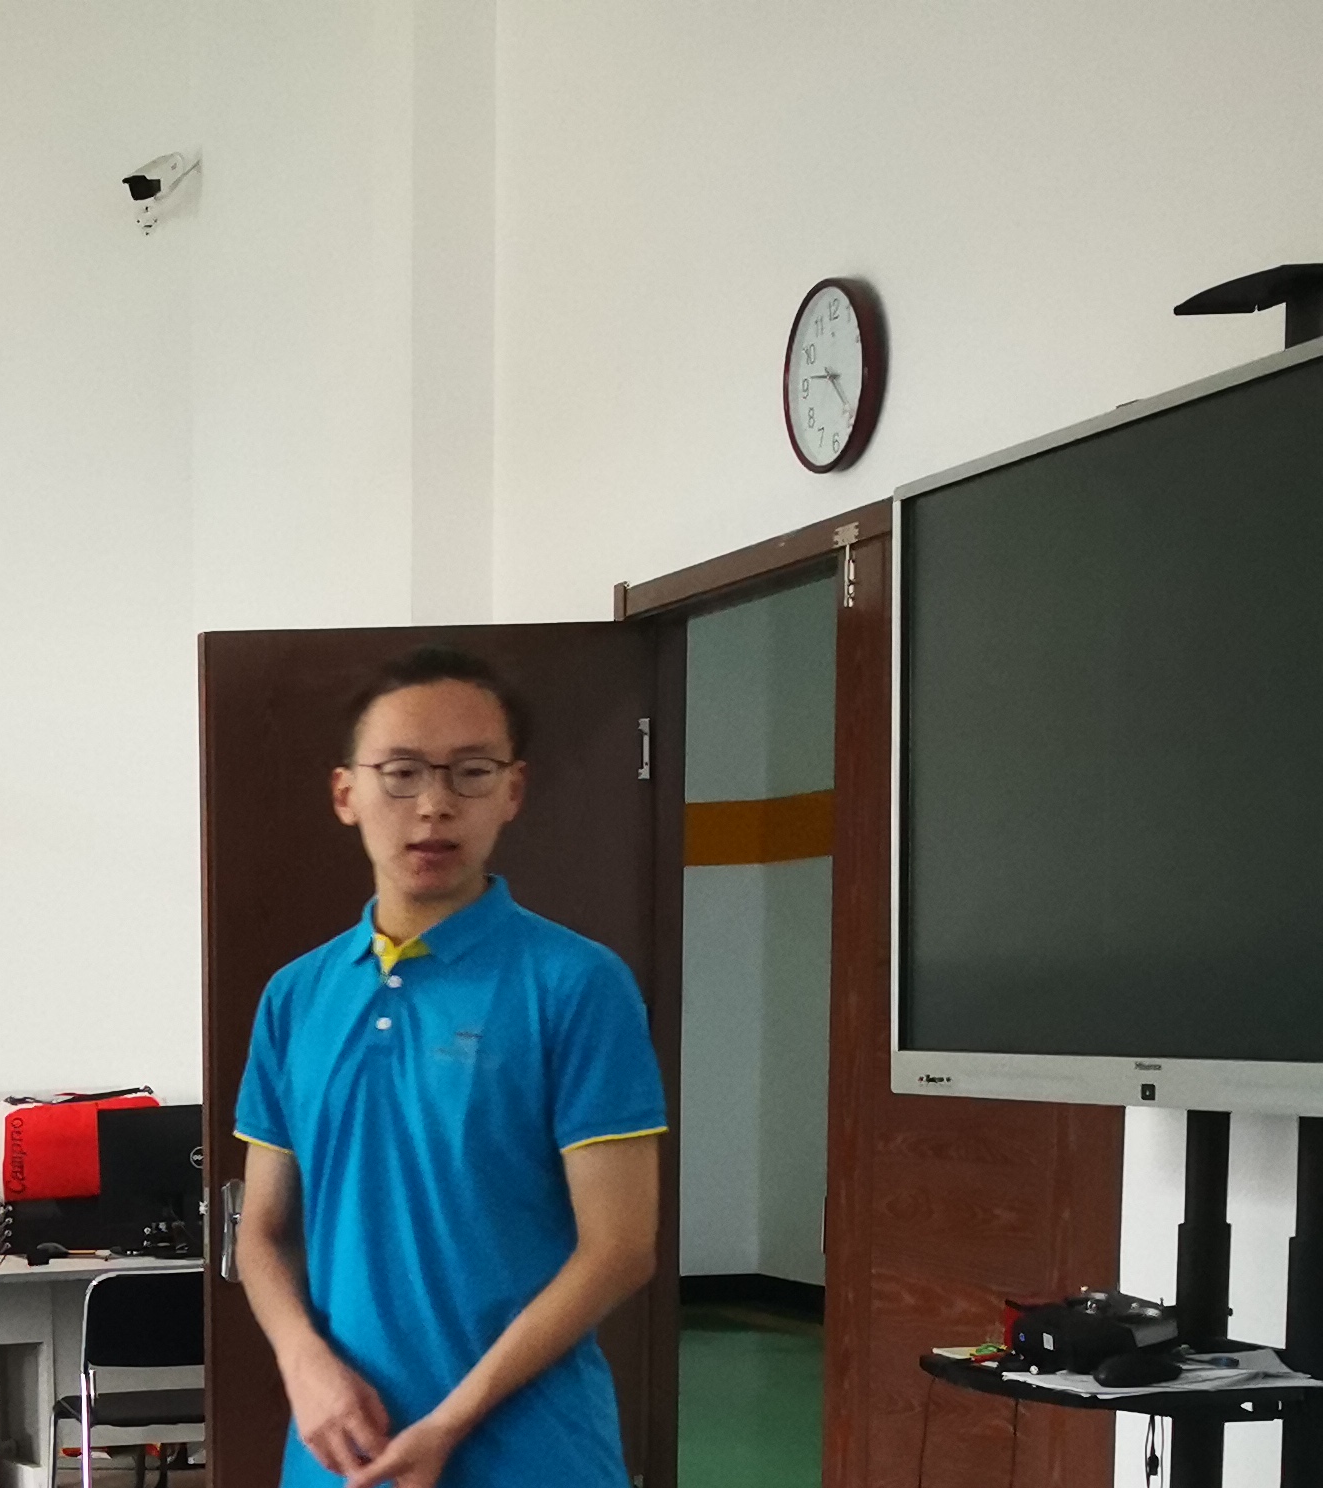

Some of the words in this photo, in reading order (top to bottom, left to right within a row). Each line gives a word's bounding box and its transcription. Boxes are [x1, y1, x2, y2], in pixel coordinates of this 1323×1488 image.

[828, 298, 840, 321] 12
[815, 315, 825, 337] 11
[802, 344, 816, 365] 10
[802, 378, 810, 400] 9
[808, 407, 816, 429] 8
[818, 427, 825, 449] 7
[833, 432, 841, 454] 6
